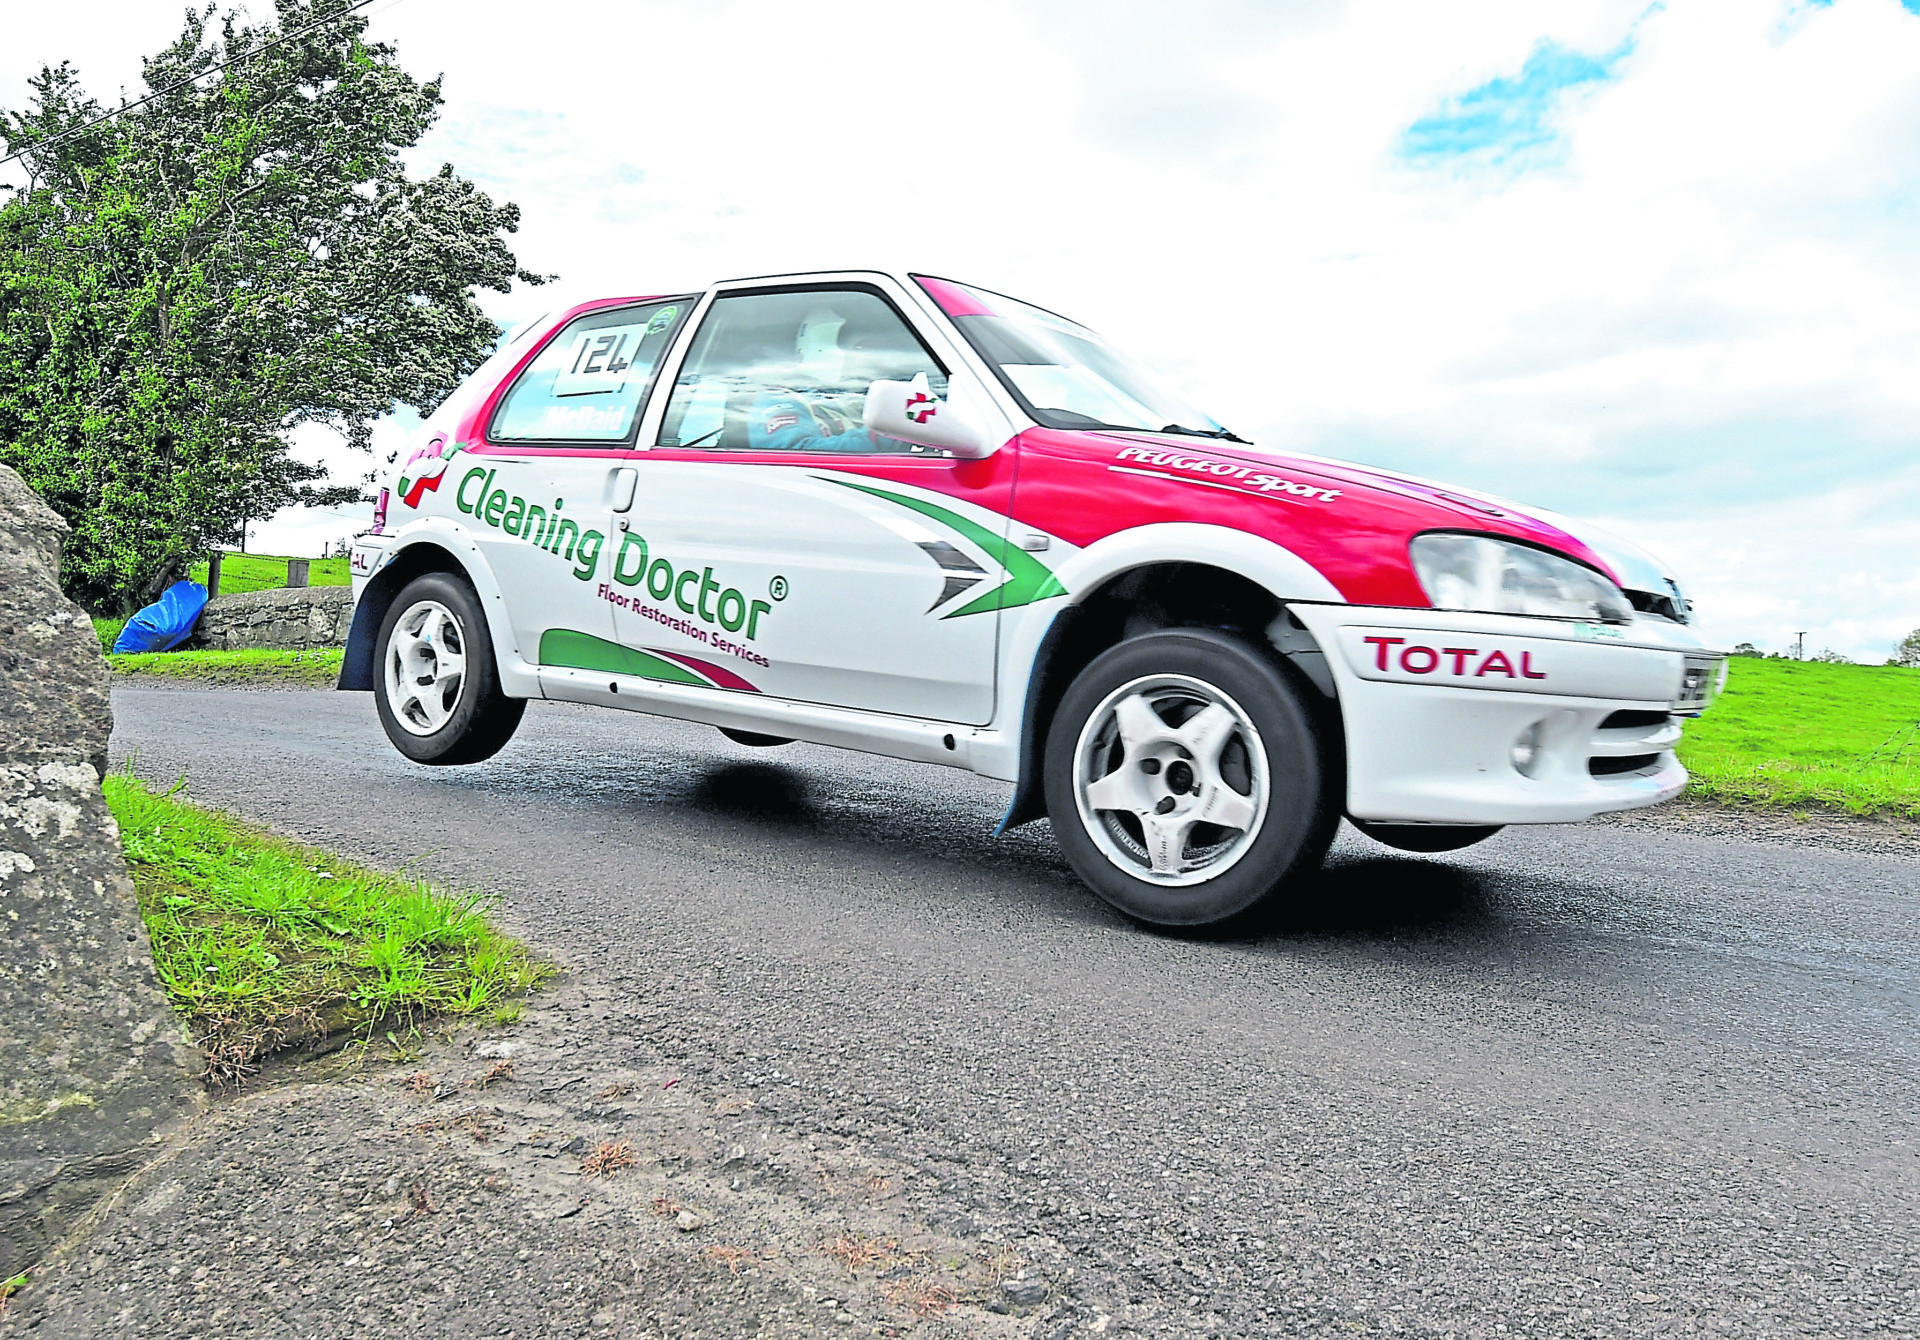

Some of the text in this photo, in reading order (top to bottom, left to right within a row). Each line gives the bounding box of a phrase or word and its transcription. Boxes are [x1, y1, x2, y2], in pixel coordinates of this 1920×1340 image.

[571, 333, 628, 374] 124
[1116, 447, 1258, 480] PEUGEOT
[456, 467, 605, 582] Cleaning
[613, 531, 772, 641] Doctor
[597, 583, 770, 668] Floor Restoration Services
[1363, 635, 1547, 680] TOTAL
